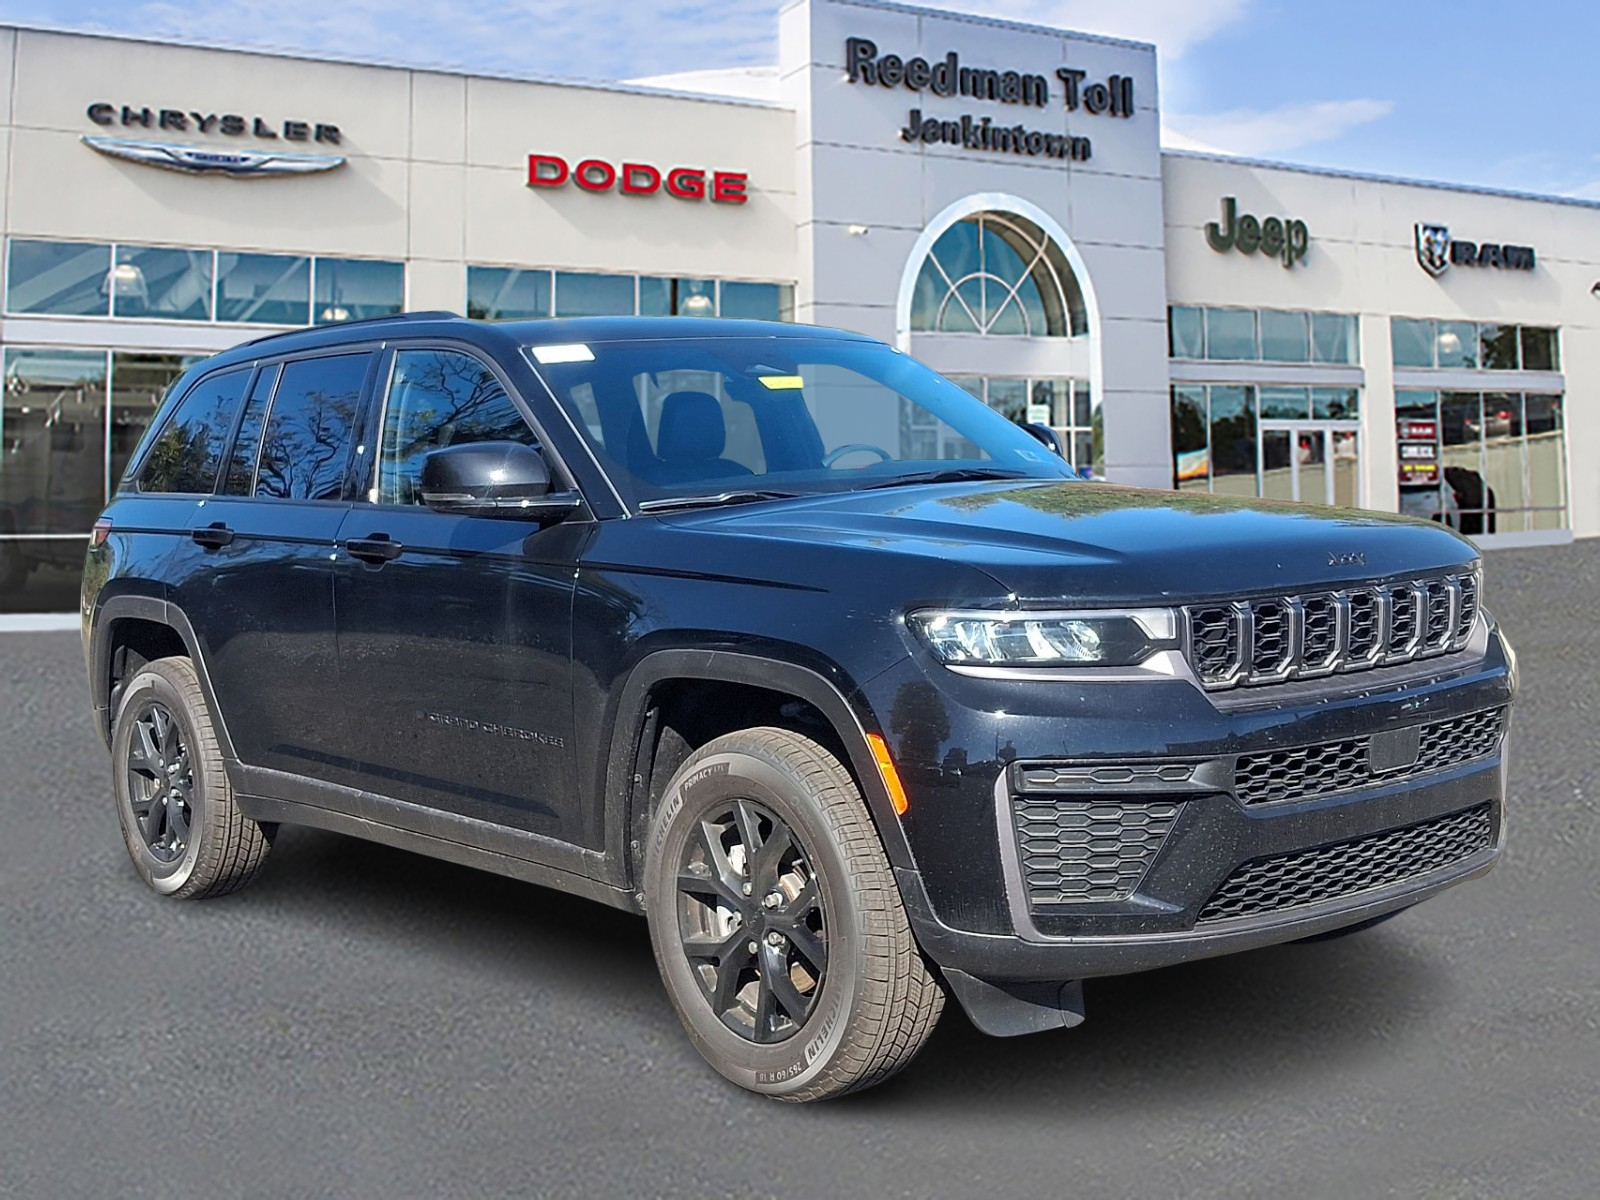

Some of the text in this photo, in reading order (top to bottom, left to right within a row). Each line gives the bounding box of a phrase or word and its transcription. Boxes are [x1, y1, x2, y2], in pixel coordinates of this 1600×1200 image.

[845, 36, 1134, 119] Reedman Toll
[86, 102, 342, 145] CHRYSLER
[901, 109, 1092, 161] Jenkintown
[526, 154, 749, 205] DODGE
[1204, 196, 1309, 270] Jeep
[1451, 240, 1536, 271] RAM
[429, 711, 565, 749] GRAND CHEROKEE
[650, 793, 681, 861] ICHELIN
[776, 1061, 802, 1079] 265/60
